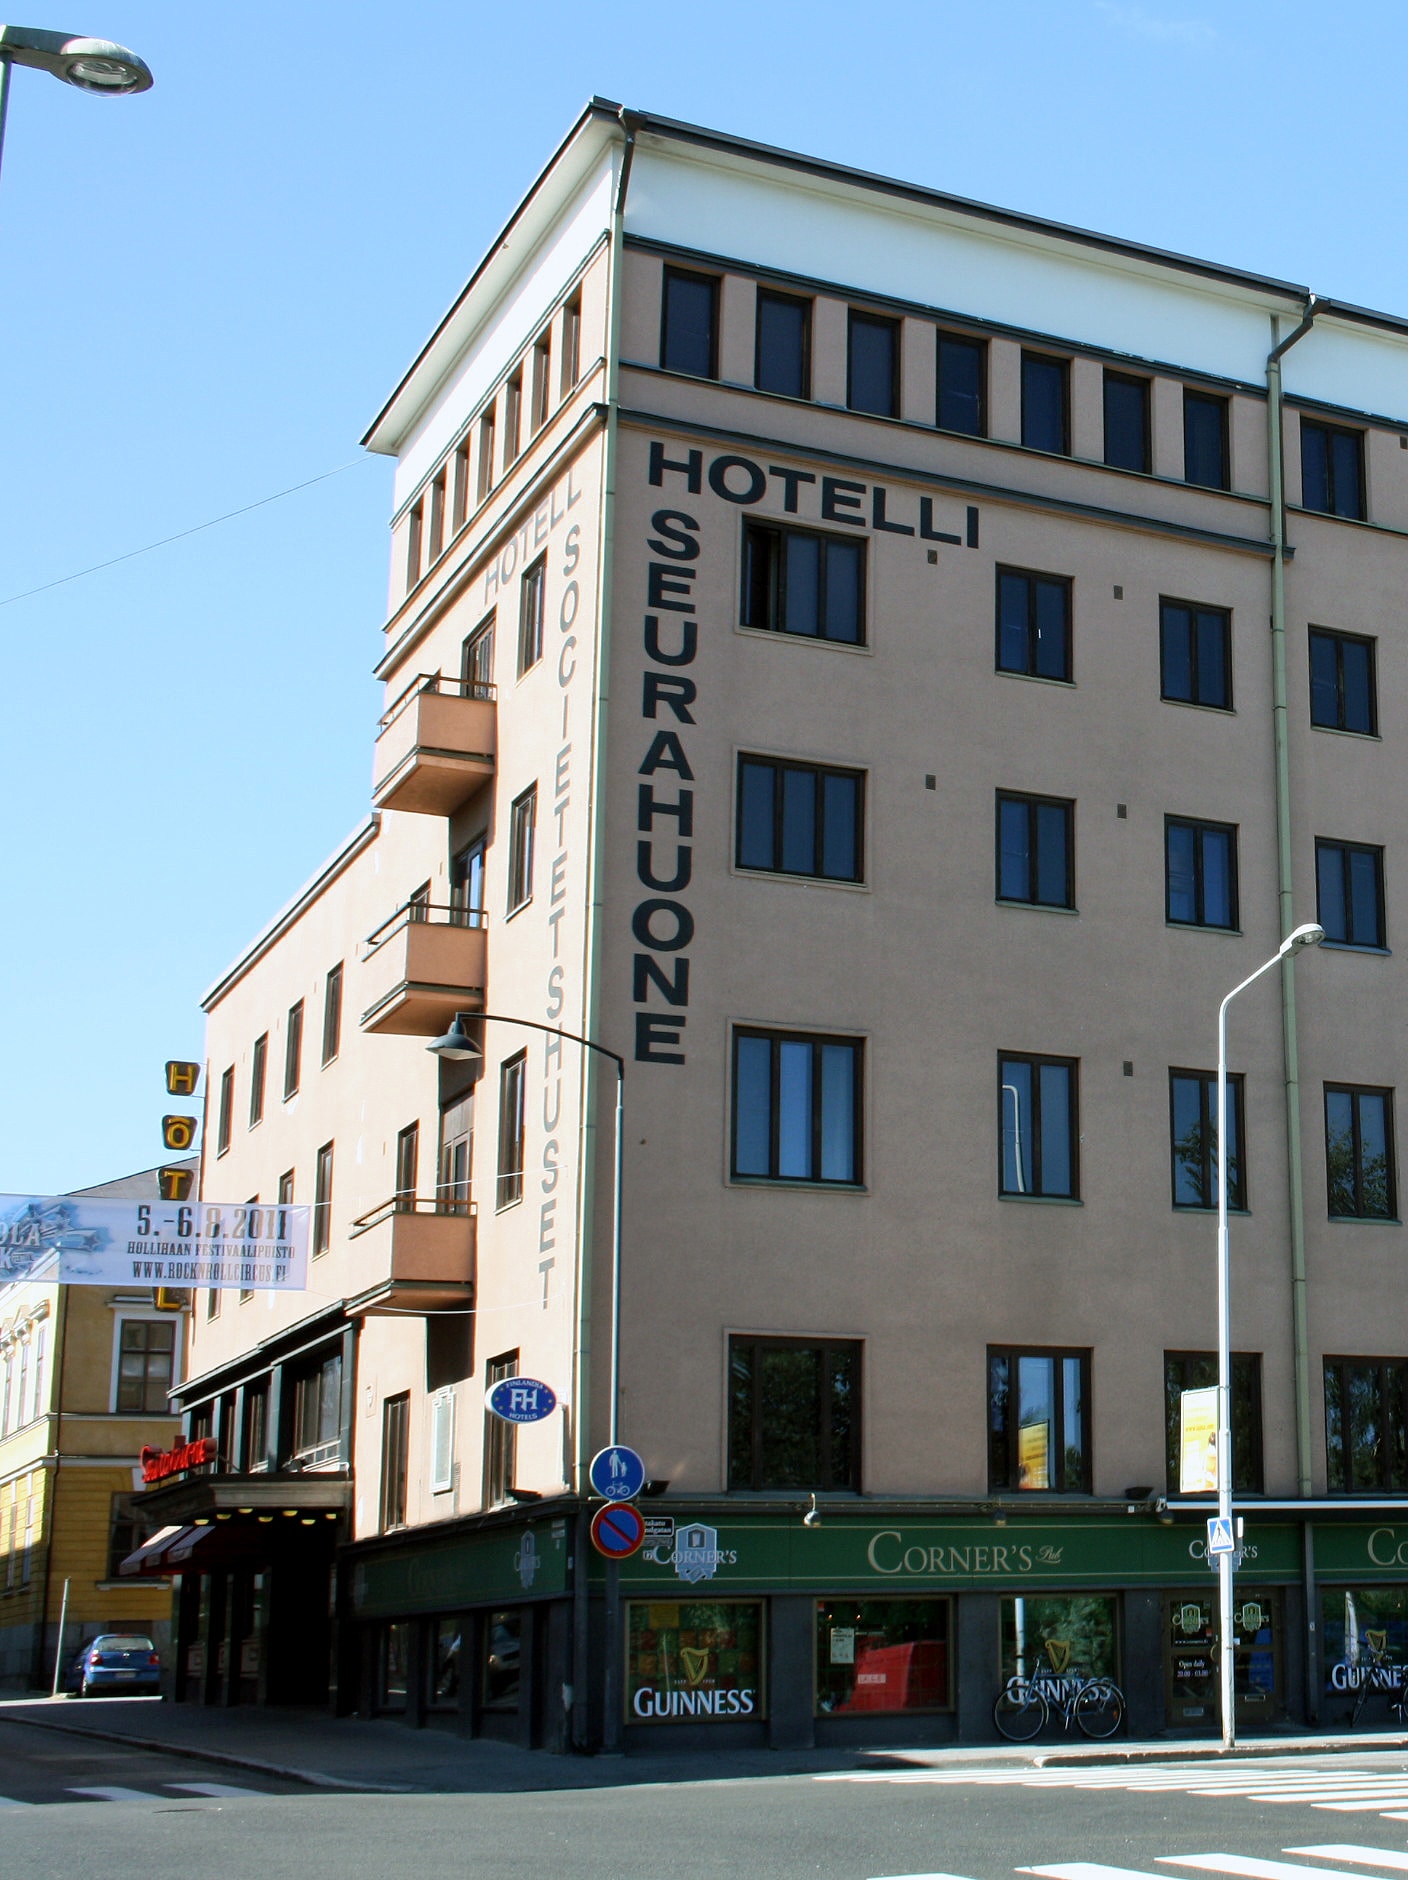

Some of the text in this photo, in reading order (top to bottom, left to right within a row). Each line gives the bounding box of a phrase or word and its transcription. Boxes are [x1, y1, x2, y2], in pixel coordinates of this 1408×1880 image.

[649, 440, 980, 551] HOTELLI
[482, 465, 583, 607] HOTELL
[632, 509, 702, 1066] SEURAHUONE
[538, 523, 582, 1311] SOCIETETSHUSET
[127, 1240, 296, 1259] HOLLIHAAN FESTIVAALIPUISTO
[510, 1388, 538, 1412] FH
[867, 1531, 1032, 1574] CORNER'S
[633, 1687, 754, 1717] GUINNESS
